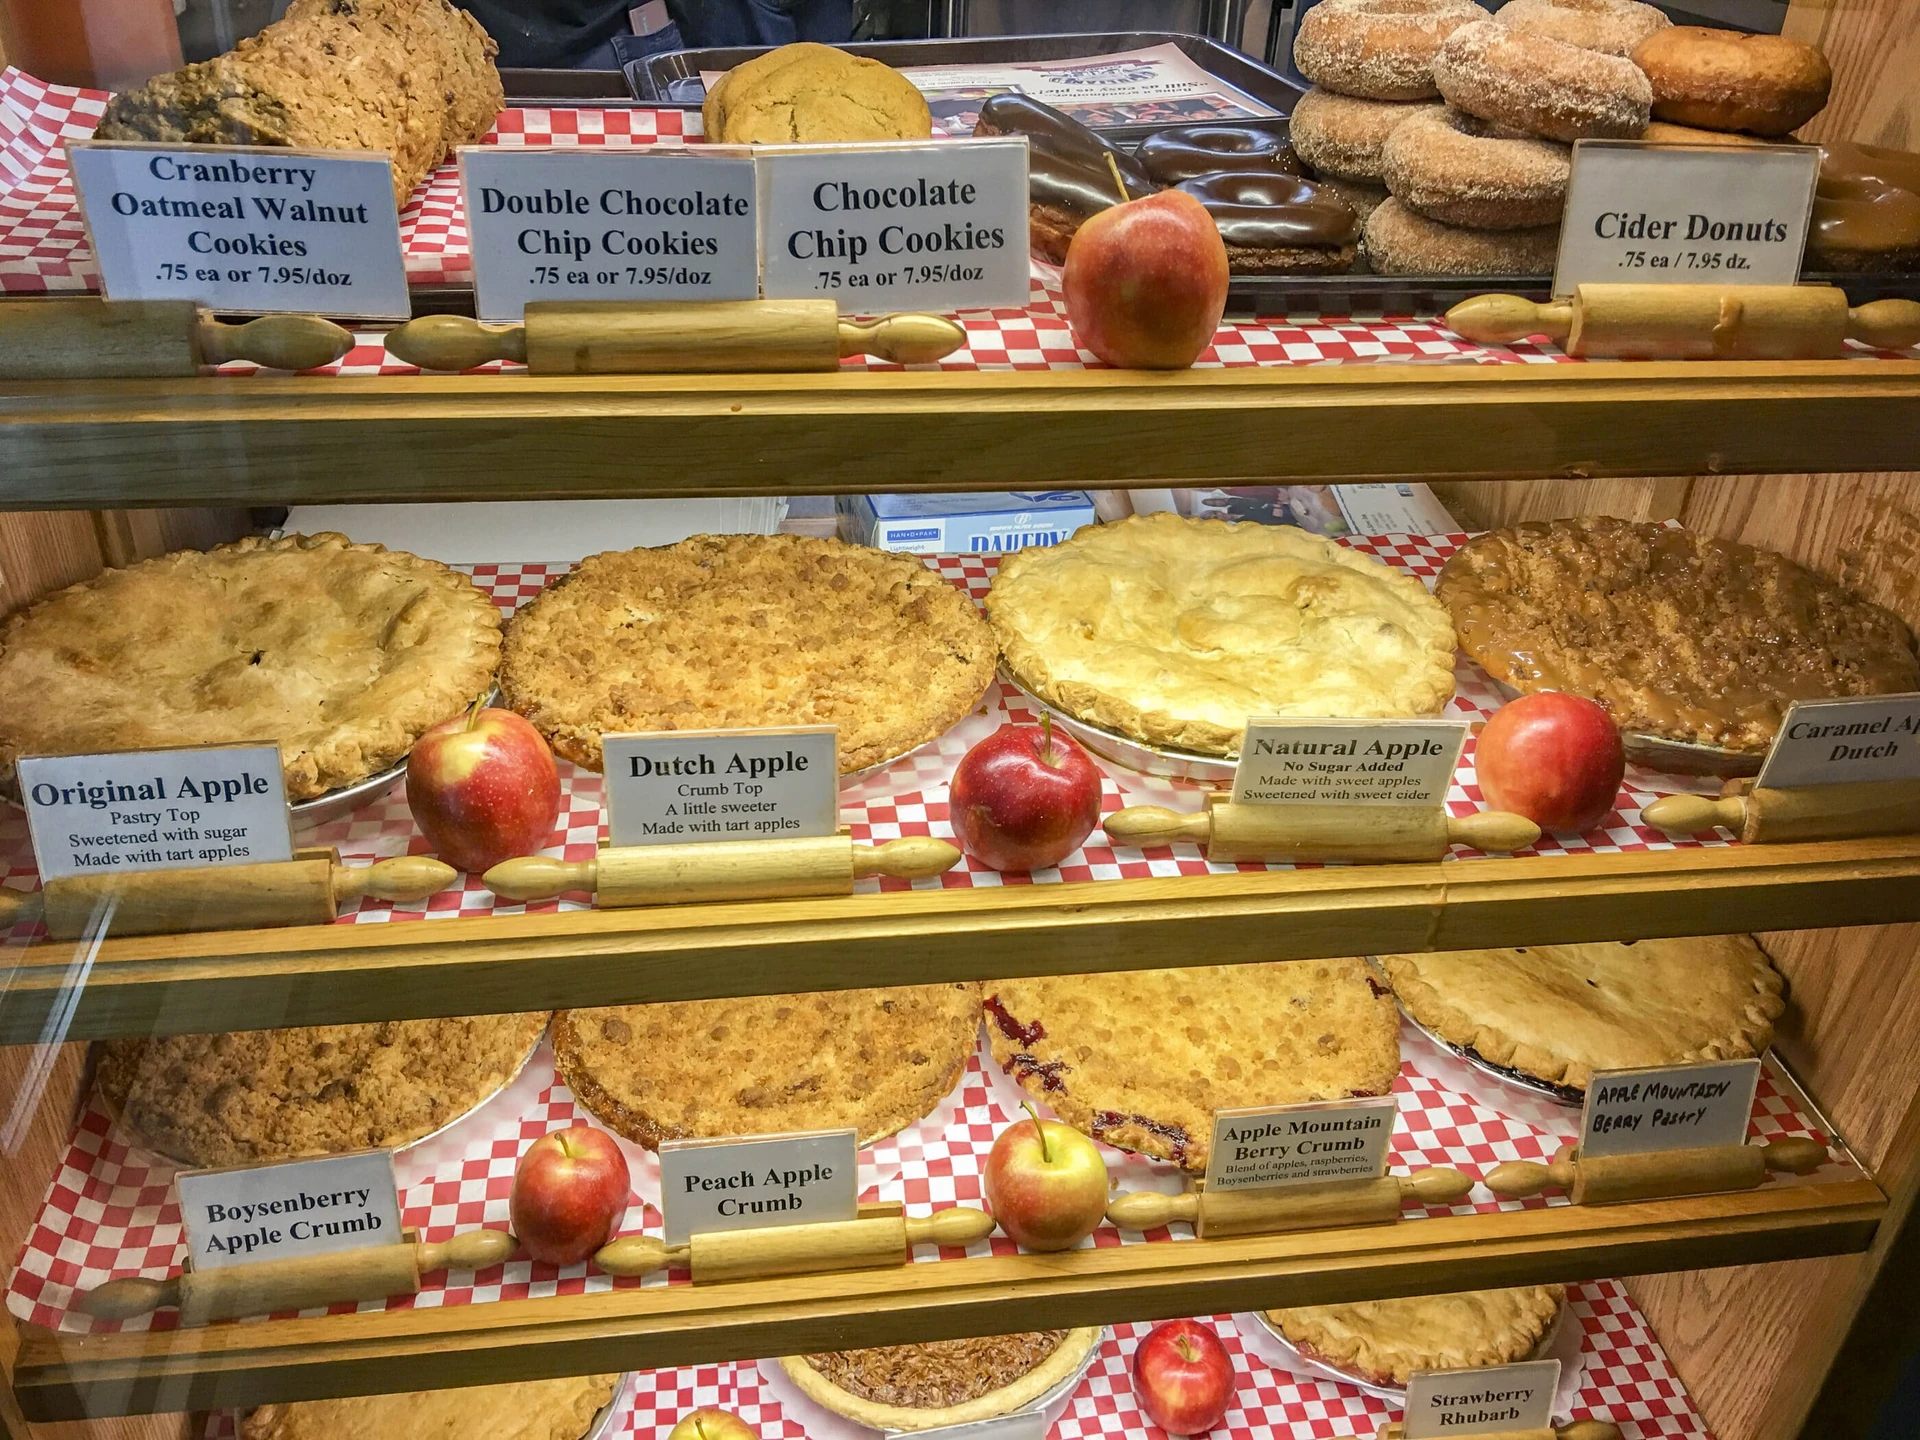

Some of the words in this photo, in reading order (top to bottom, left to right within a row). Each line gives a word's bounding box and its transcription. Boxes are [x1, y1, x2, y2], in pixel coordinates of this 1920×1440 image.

[149, 156, 316, 191] Cranberry
[479, 187, 590, 215] Double
[600, 189, 749, 216] Chocolate
[813, 178, 976, 212] Chocolate
[111, 192, 245, 220] Oatmeal
[252, 197, 368, 224] Walnut
[1594, 212, 1678, 240] Cider
[1684, 214, 1788, 242] Donuts
[187, 231, 308, 257] Cookies
[517, 228, 591, 262] Chip
[602, 230, 718, 255] Cookies
[788, 228, 867, 264] Chip
[878, 222, 1005, 254] Cookies
[1618, 251, 1645, 268] .75
[1650, 255, 1669, 269] ea
[1674, 252, 1683, 269] /
[1686, 252, 1721, 269] 7.95
[1726, 253, 1751, 270] dz.
[155, 264, 188, 282] .75
[195, 268, 220, 282] ea
[228, 269, 252, 283] or
[258, 266, 352, 286] 7.95/doz
[529, 267, 559, 284] .75
[566, 270, 589, 285] ea
[596, 270, 620, 285] or
[626, 266, 712, 285] 7.95/doz
[814, 271, 842, 290] .75
[848, 274, 870, 288] ea
[876, 272, 898, 286] or
[902, 264, 984, 284] 7.95/doz
[1788, 716, 1893, 740] Caramel
[1253, 738, 1358, 756] Natural
[1364, 738, 1444, 760] Apple
[1828, 741, 1899, 762] Dutch
[628, 753, 716, 778] Dutch
[724, 750, 809, 779] Apple
[1282, 761, 1304, 772] No
[1308, 762, 1352, 774] Sugar
[1356, 762, 1404, 772] Added
[31, 777, 166, 810] Original
[176, 772, 269, 804] Apple
[677, 782, 729, 797] Crumb
[733, 782, 764, 797] Top
[1259, 775, 1298, 786] Made
[1302, 775, 1332, 786] with
[1336, 776, 1374, 786] sweet
[1377, 776, 1422, 788] apples
[1243, 789, 1316, 800] Sweetened
[1320, 789, 1350, 800] with
[1354, 790, 1393, 800] sweet
[1396, 790, 1431, 800] cider
[110, 810, 162, 826] Pastry
[166, 808, 200, 824] Top
[664, 803, 678, 816] A
[683, 800, 717, 815] little
[720, 800, 778, 814] sweeter
[68, 829, 158, 848] Sweetened
[162, 826, 200, 842] with
[204, 826, 248, 840] sugar
[642, 820, 684, 836] Made
[688, 818, 722, 833] with
[725, 819, 750, 832] tart
[754, 817, 800, 832] apples
[73, 851, 120, 867] Made
[125, 848, 162, 864] with
[166, 848, 194, 862] tart
[198, 844, 250, 862] apples
[1596, 1083, 1641, 1106] APPLE
[1642, 1080, 1731, 1103] MOUNTAIN
[1223, 1123, 1282, 1144] Apple
[1288, 1116, 1382, 1135] Mountain
[1592, 1114, 1643, 1134] BERRY
[1234, 1144, 1290, 1161] Berry
[1296, 1136, 1366, 1155] Crumb
[1216, 1172, 1289, 1186] Boysenberries
[1291, 1168, 1310, 1178] and
[1312, 1164, 1374, 1176] strawberries
[1226, 1162, 1256, 1174] Blend
[1258, 1160, 1270, 1170] of
[1272, 1159, 1308, 1171] apples,
[1310, 1154, 1368, 1167] raspberries,
[684, 1170, 755, 1194] Peach
[762, 1164, 834, 1189] Apple
[206, 1188, 371, 1224] Boysenberry
[717, 1193, 803, 1216] Crumb
[205, 1227, 282, 1255] Apple
[289, 1212, 382, 1240] Crumb
[1430, 1388, 1535, 1408] Strawberry
[1439, 1407, 1520, 1426] Rhubarb
